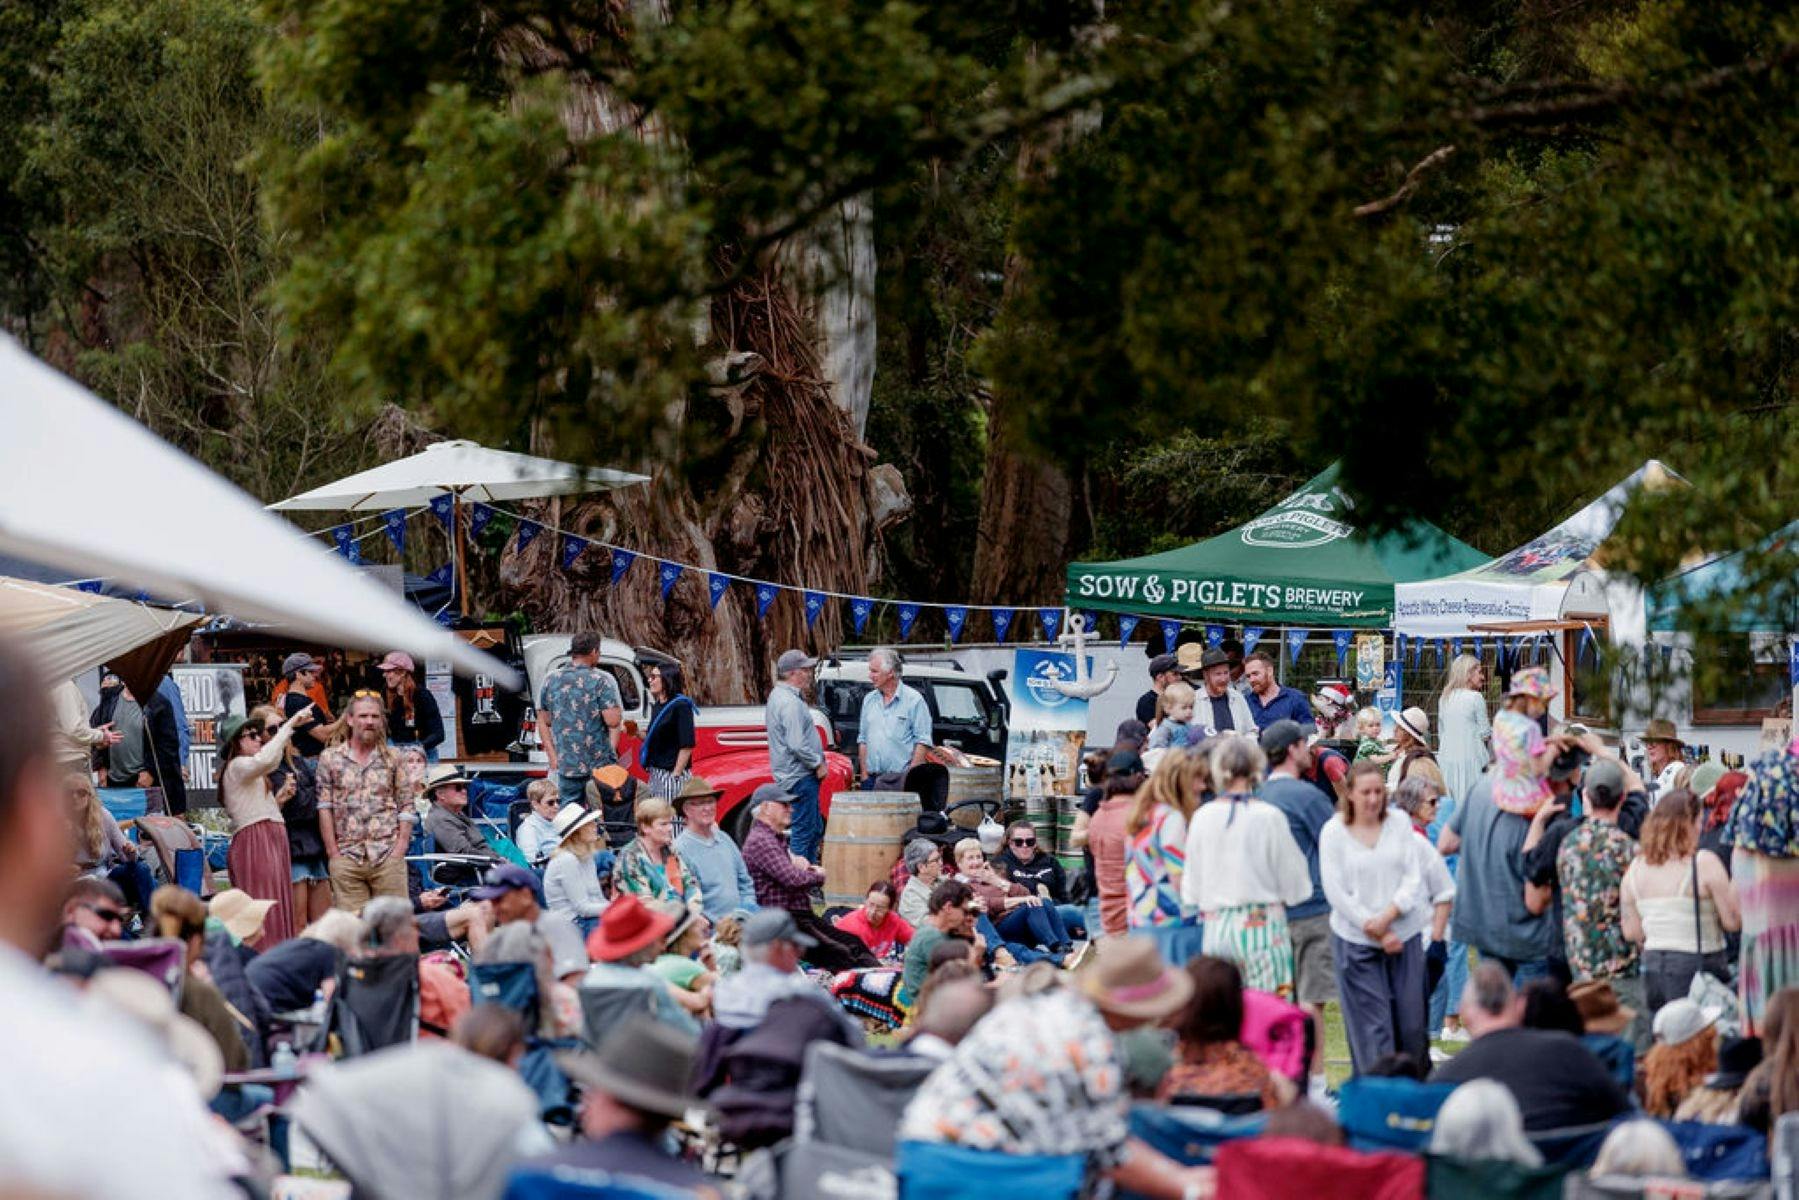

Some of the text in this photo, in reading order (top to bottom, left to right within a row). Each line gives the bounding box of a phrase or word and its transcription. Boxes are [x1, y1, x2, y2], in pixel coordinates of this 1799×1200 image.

[1079, 573, 1364, 609] SOW & PIGLETS BREWERY
[194, 720, 216, 744] THE
[186, 752, 218, 789] INE
